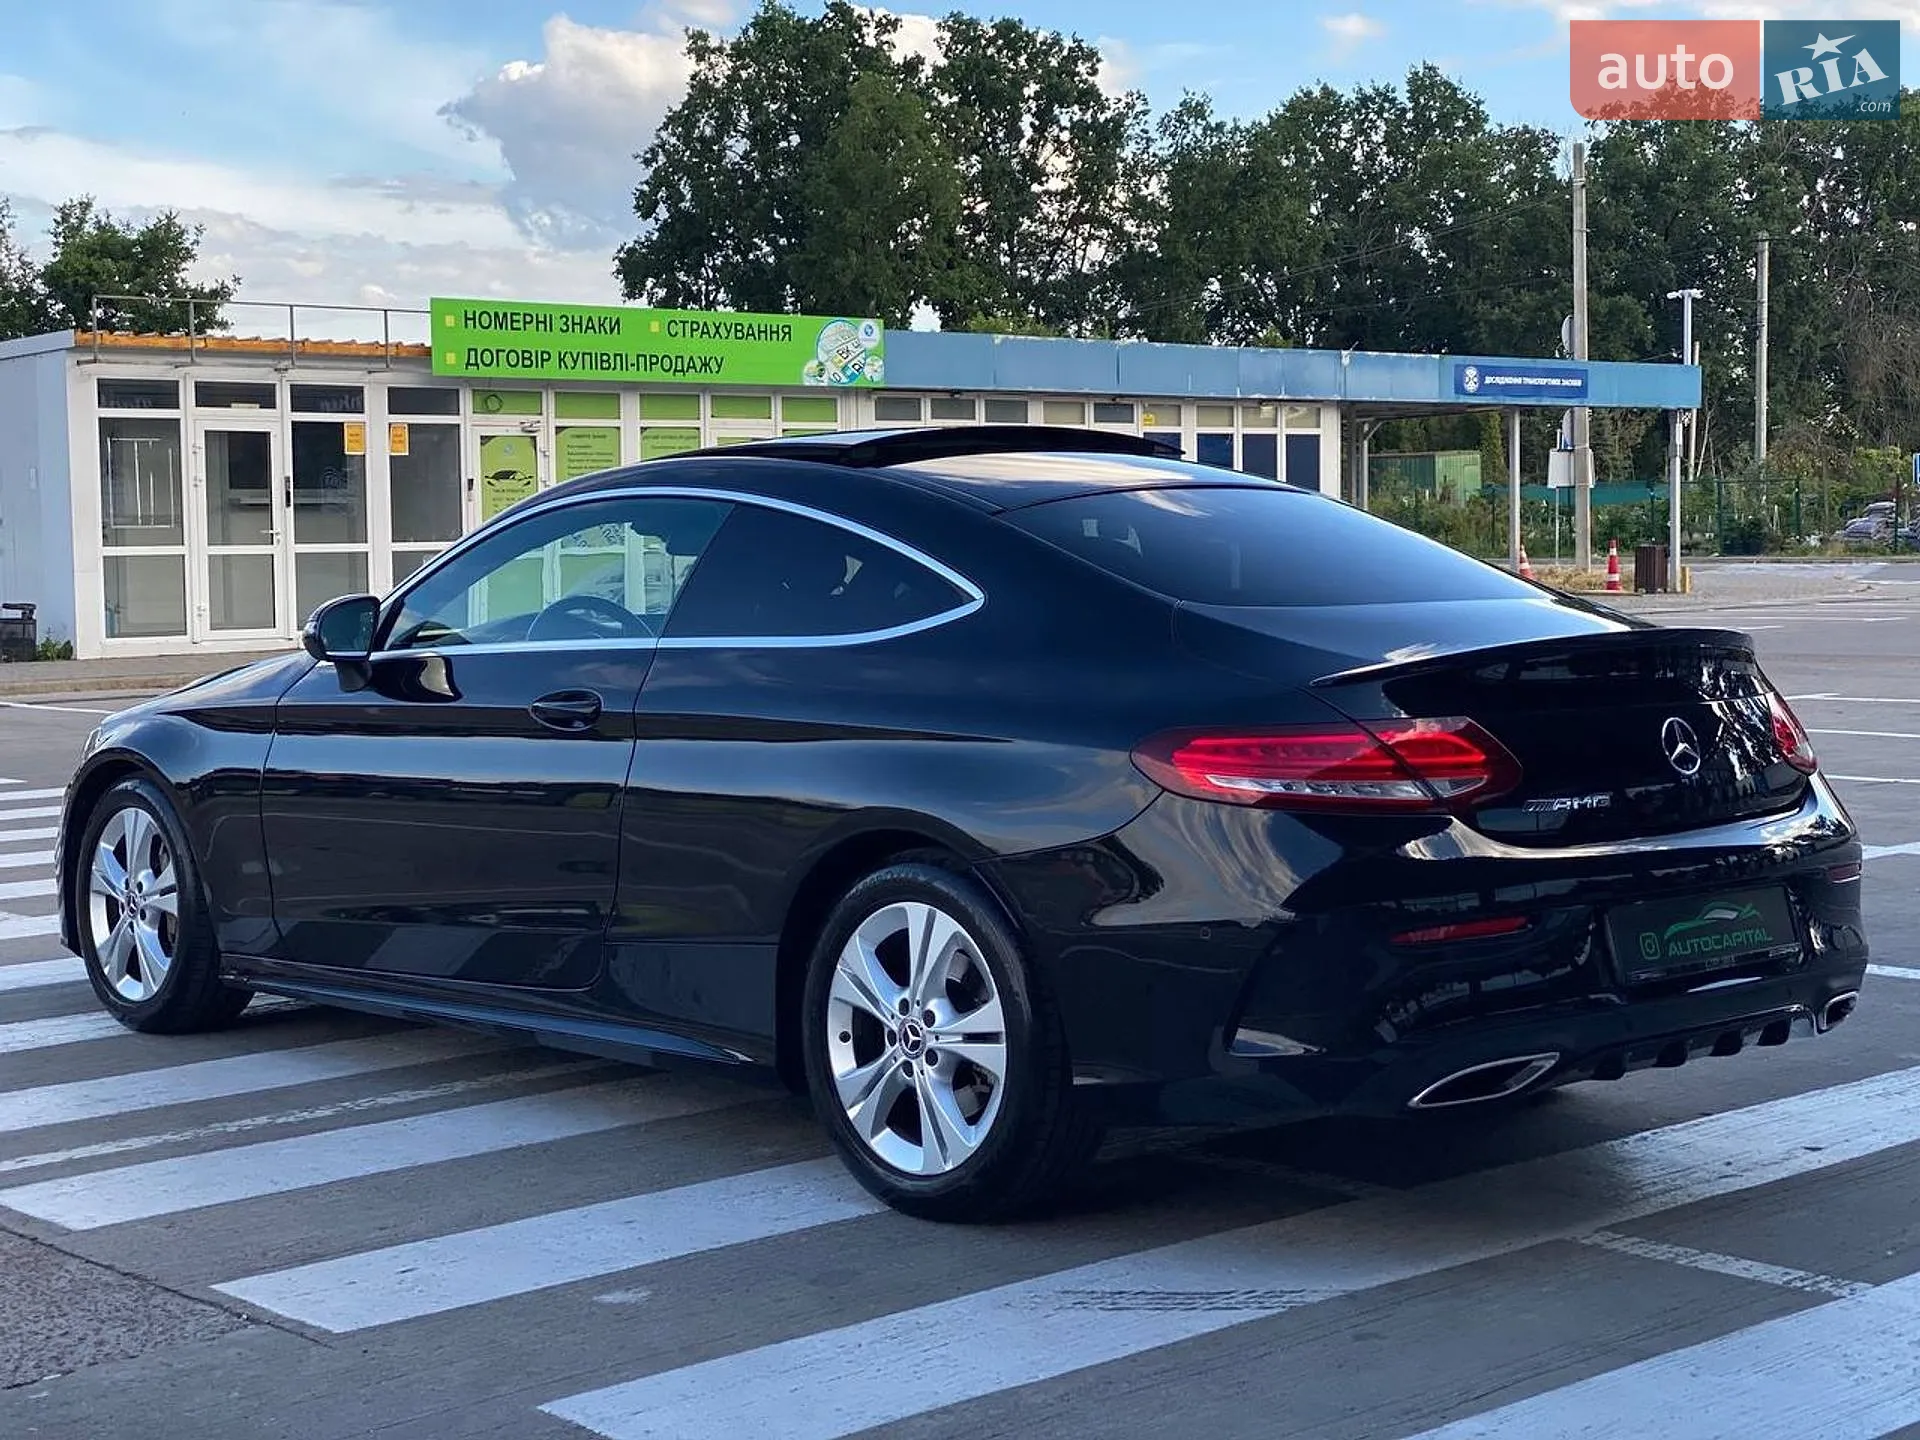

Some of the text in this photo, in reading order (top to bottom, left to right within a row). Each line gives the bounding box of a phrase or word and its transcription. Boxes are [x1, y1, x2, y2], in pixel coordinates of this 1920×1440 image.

[463, 309, 622, 336] НОМЕРНІ ЗНАКИ
[666, 319, 793, 342] СТРАХУВАННЯ
[464, 347, 725, 376] ДОГОВІР КУПІВЛІ-ПРОДАЖУ
[1552, 793, 1611, 812] AMG
[1667, 927, 1774, 958] AUTOCAPITAL
